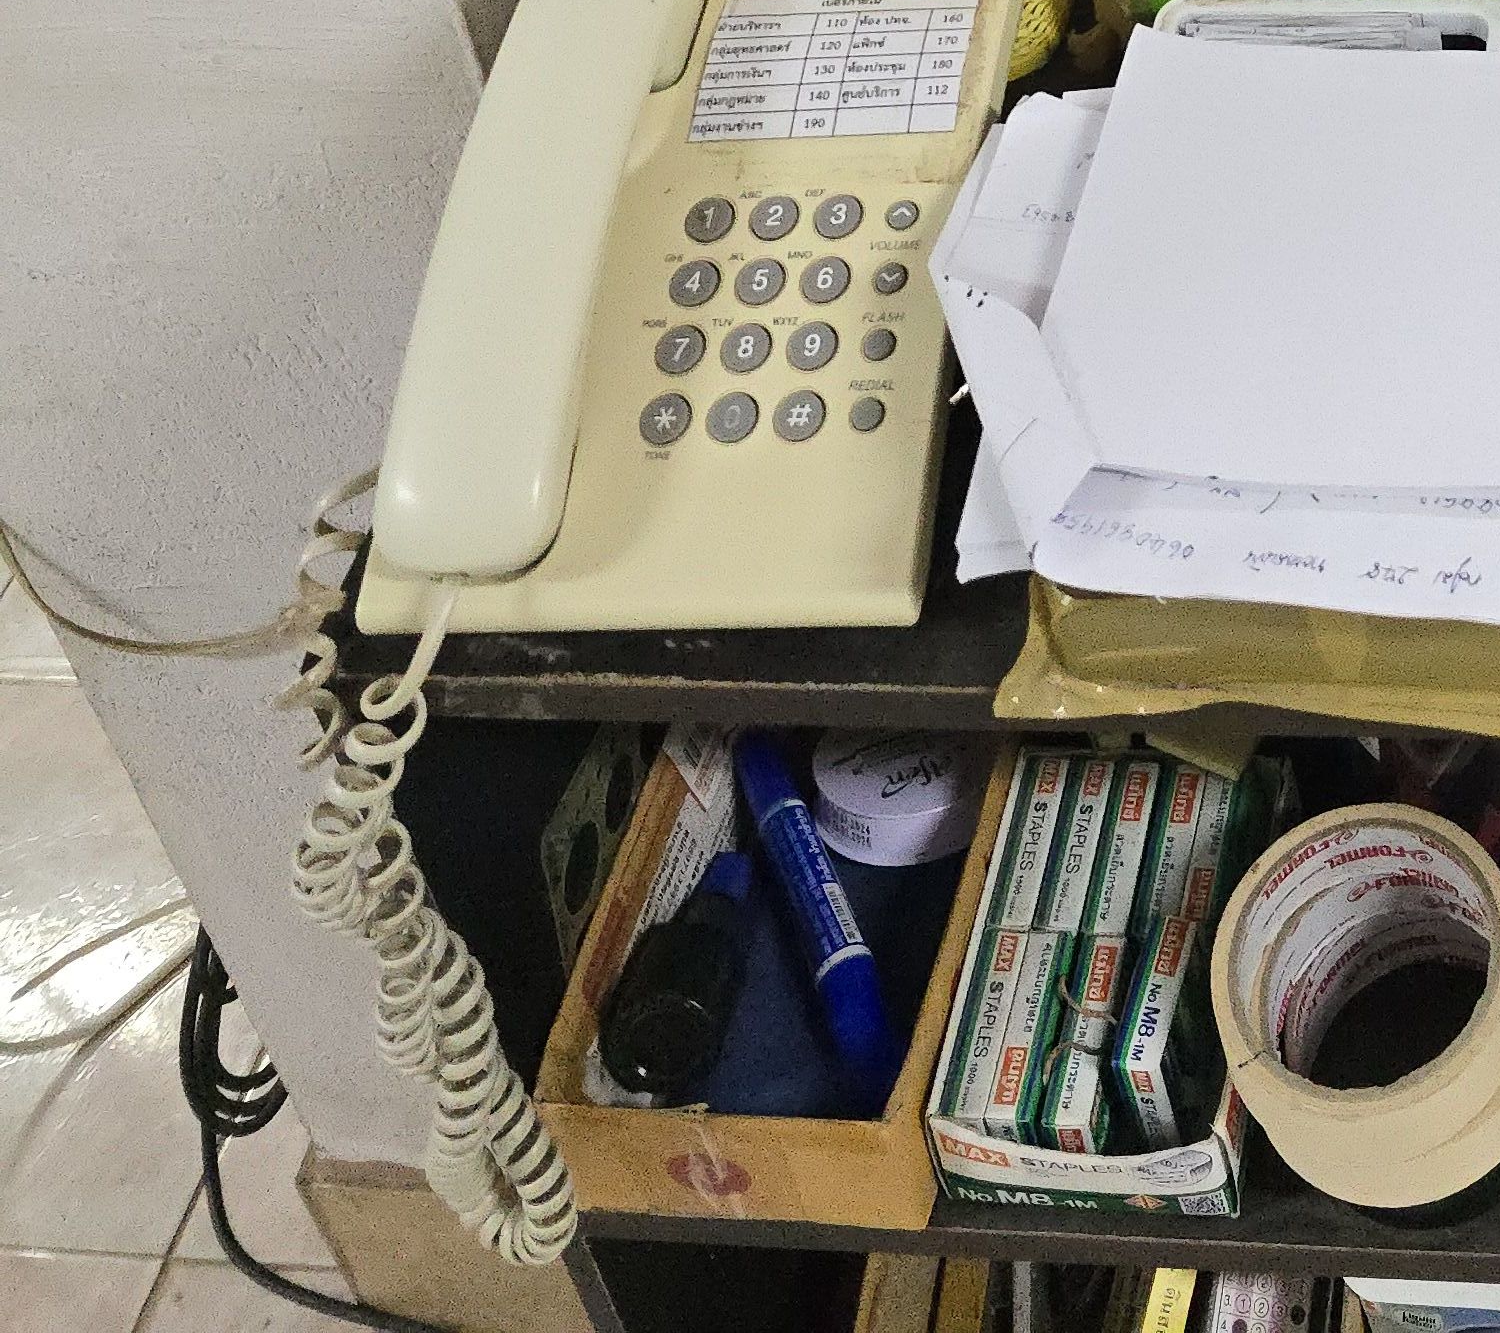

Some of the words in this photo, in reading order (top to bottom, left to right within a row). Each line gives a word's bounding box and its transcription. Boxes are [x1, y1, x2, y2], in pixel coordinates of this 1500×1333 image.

[825, 17, 848, 29] 110
[942, 13, 964, 24] 160
[819, 40, 842, 51] 120
[936, 34, 959, 46] 170
[813, 63, 836, 76] 130
[931, 58, 953, 70] 180
[807, 90, 831, 102] 140
[926, 84, 950, 96] 112
[803, 117, 827, 129] 190
[702, 207, 715, 229] 1
[764, 204, 784, 227] 2
[829, 203, 848, 226] 3
[684, 270, 701, 293] 4
[752, 268, 770, 291] 5
[817, 266, 835, 290] 6
[861, 311, 906, 324] FLASH
[673, 337, 691, 362] 7
[737, 335, 755, 358] 8
[803, 333, 821, 357] 9
[848, 379, 894, 391] REDIAL
[1036, 756, 1062, 795] MAX
[1082, 761, 1109, 797] MAX
[1019, 799, 1049, 872] STAPLES
[1065, 802, 1094, 874] STAPLES
[992, 934, 1019, 972] MAX
[973, 980, 1004, 1059] STAPLES
[940, 1134, 1010, 1167] MAX
[1019, 1156, 1123, 1176] STAPLES
